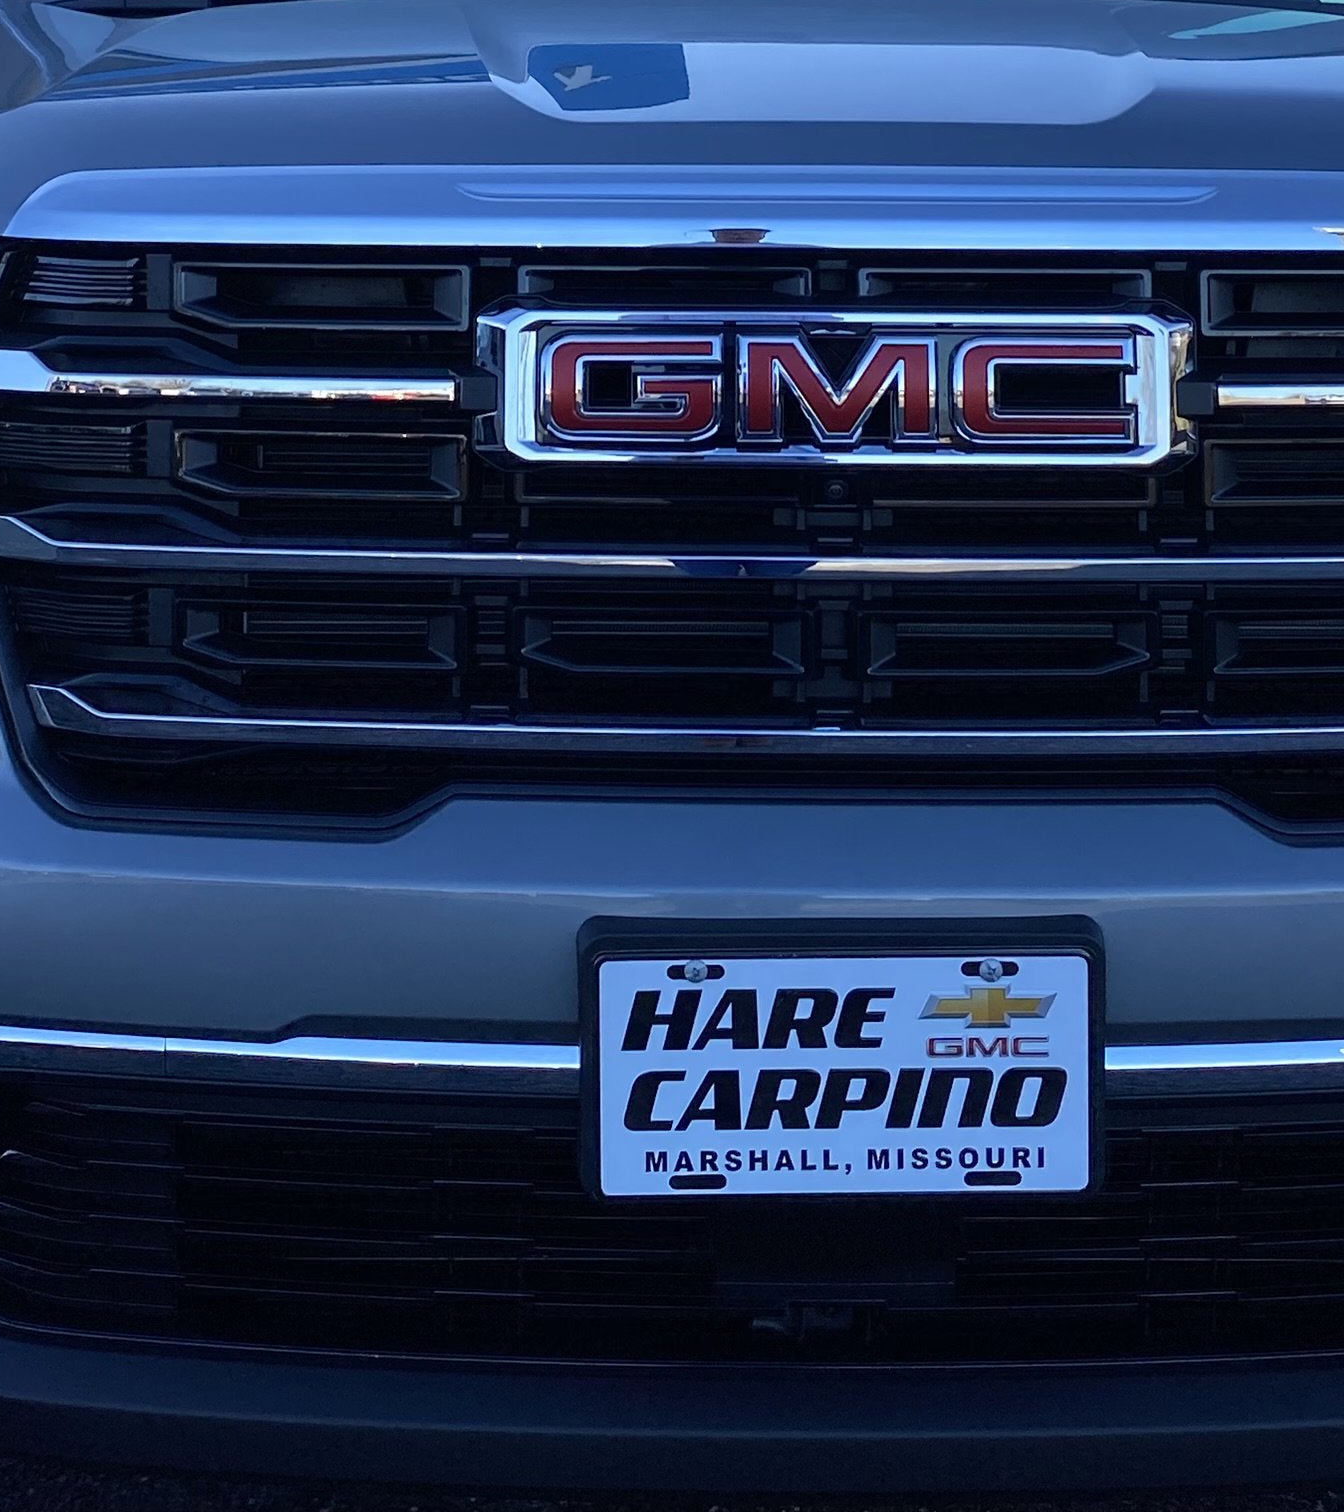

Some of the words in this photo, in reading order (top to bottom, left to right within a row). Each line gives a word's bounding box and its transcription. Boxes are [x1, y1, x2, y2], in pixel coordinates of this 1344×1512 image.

[540, 333, 1136, 444] GMC
[620, 987, 896, 1052] HARE
[926, 1035, 1050, 1058] GMC
[623, 1066, 1068, 1132] CARPINO
[644, 1149, 853, 1174] MARSHALL,
[867, 1146, 1046, 1170] MISSOURI
